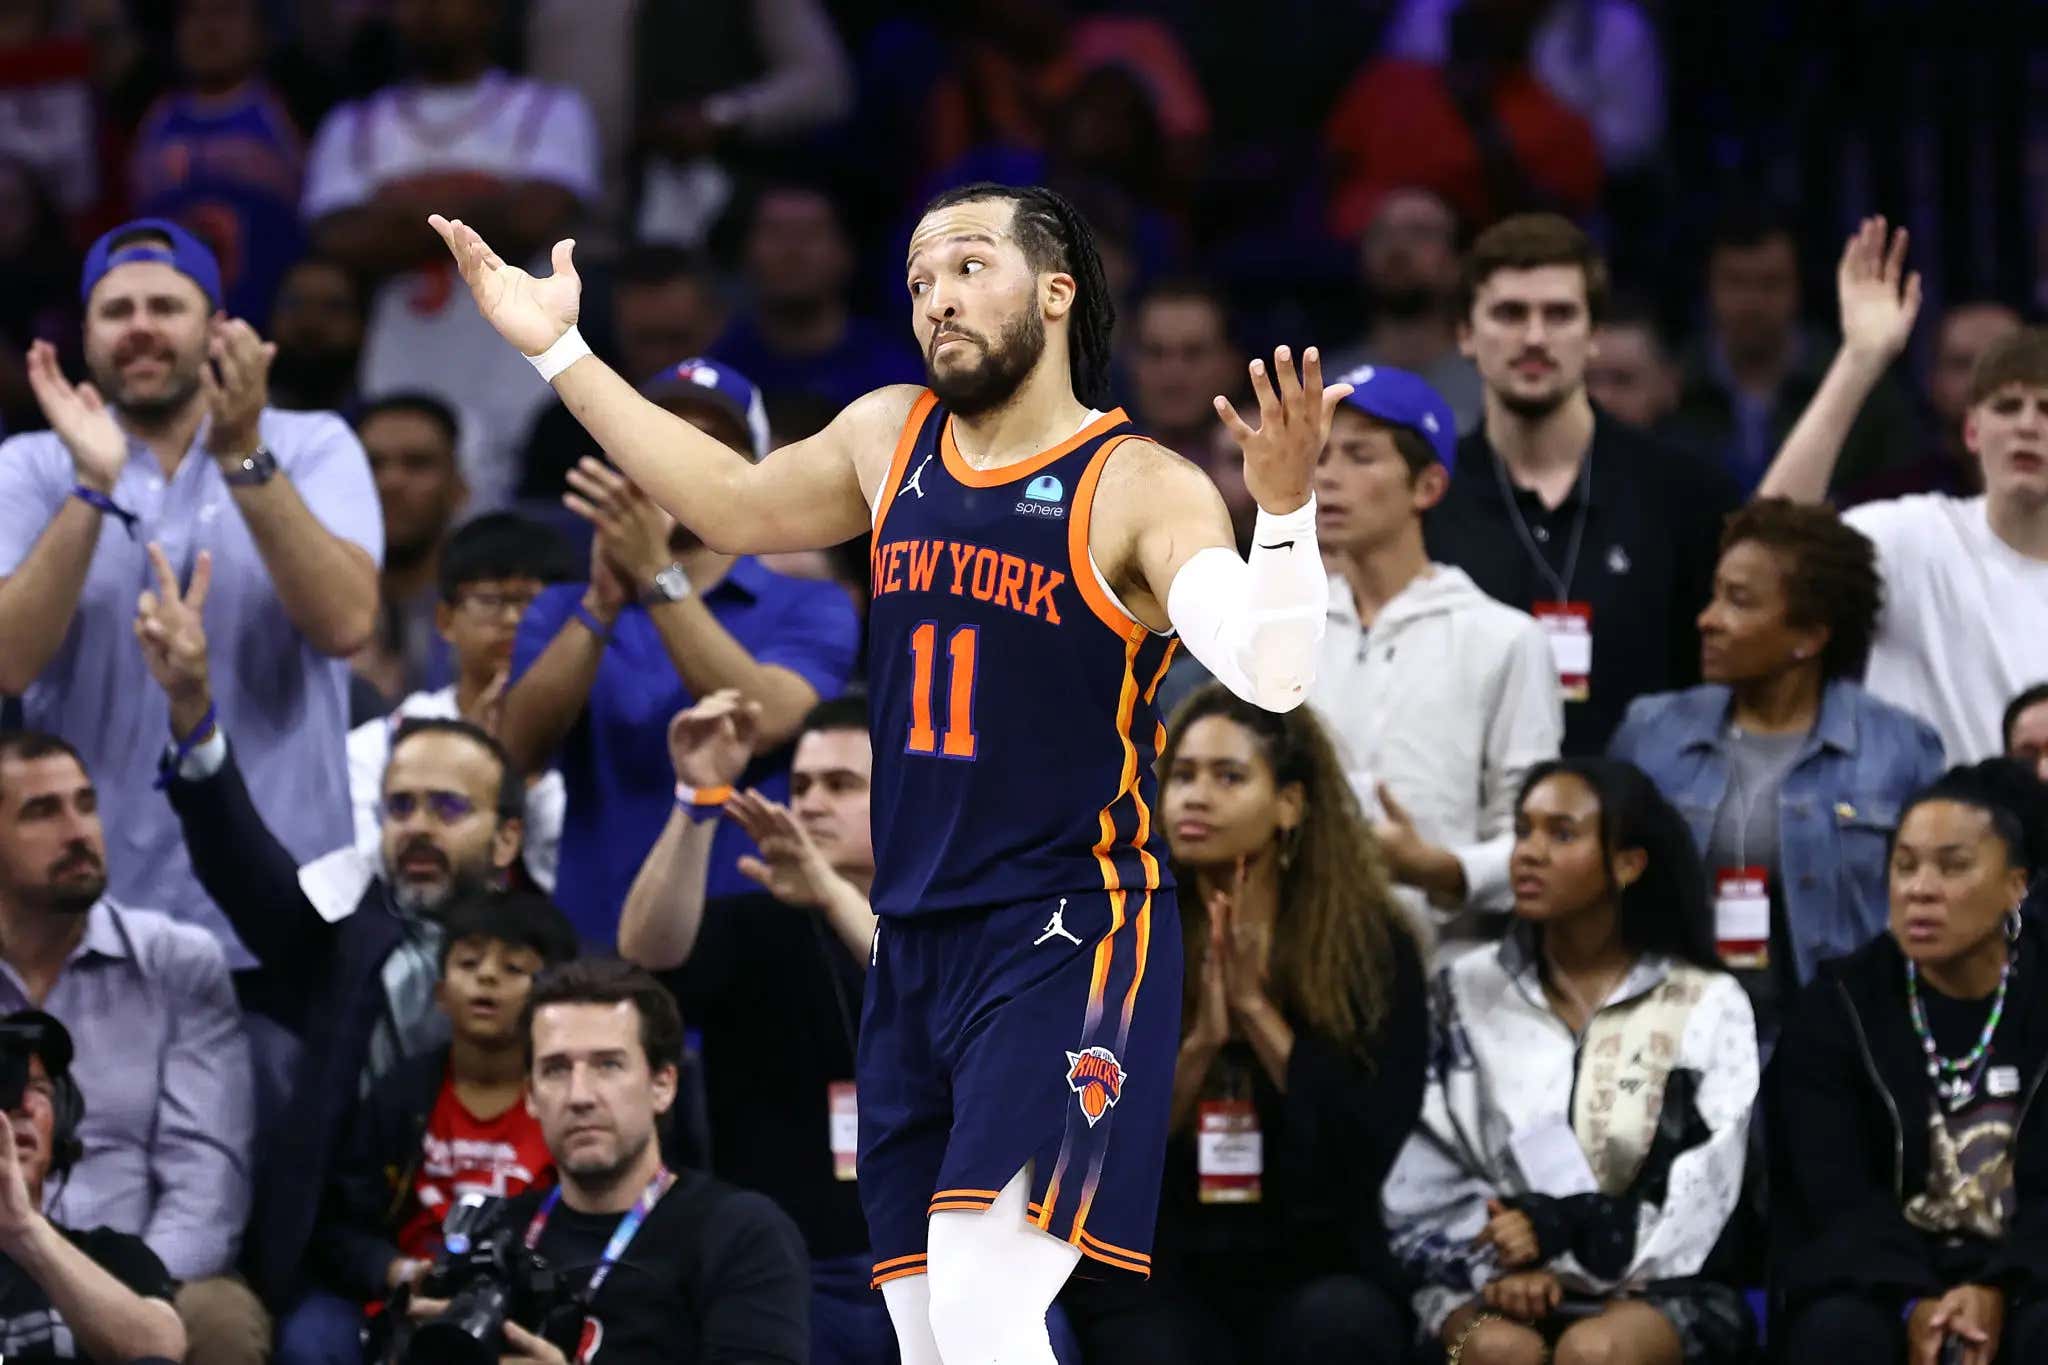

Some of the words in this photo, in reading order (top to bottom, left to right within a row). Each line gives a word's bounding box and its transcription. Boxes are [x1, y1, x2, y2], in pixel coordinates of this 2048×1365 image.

[1015, 502, 1063, 517] sphere
[873, 540, 944, 599] NEW
[948, 542, 1065, 625] YORK
[905, 620, 979, 760] 11
[1071, 1053, 1119, 1097] KNICKS
